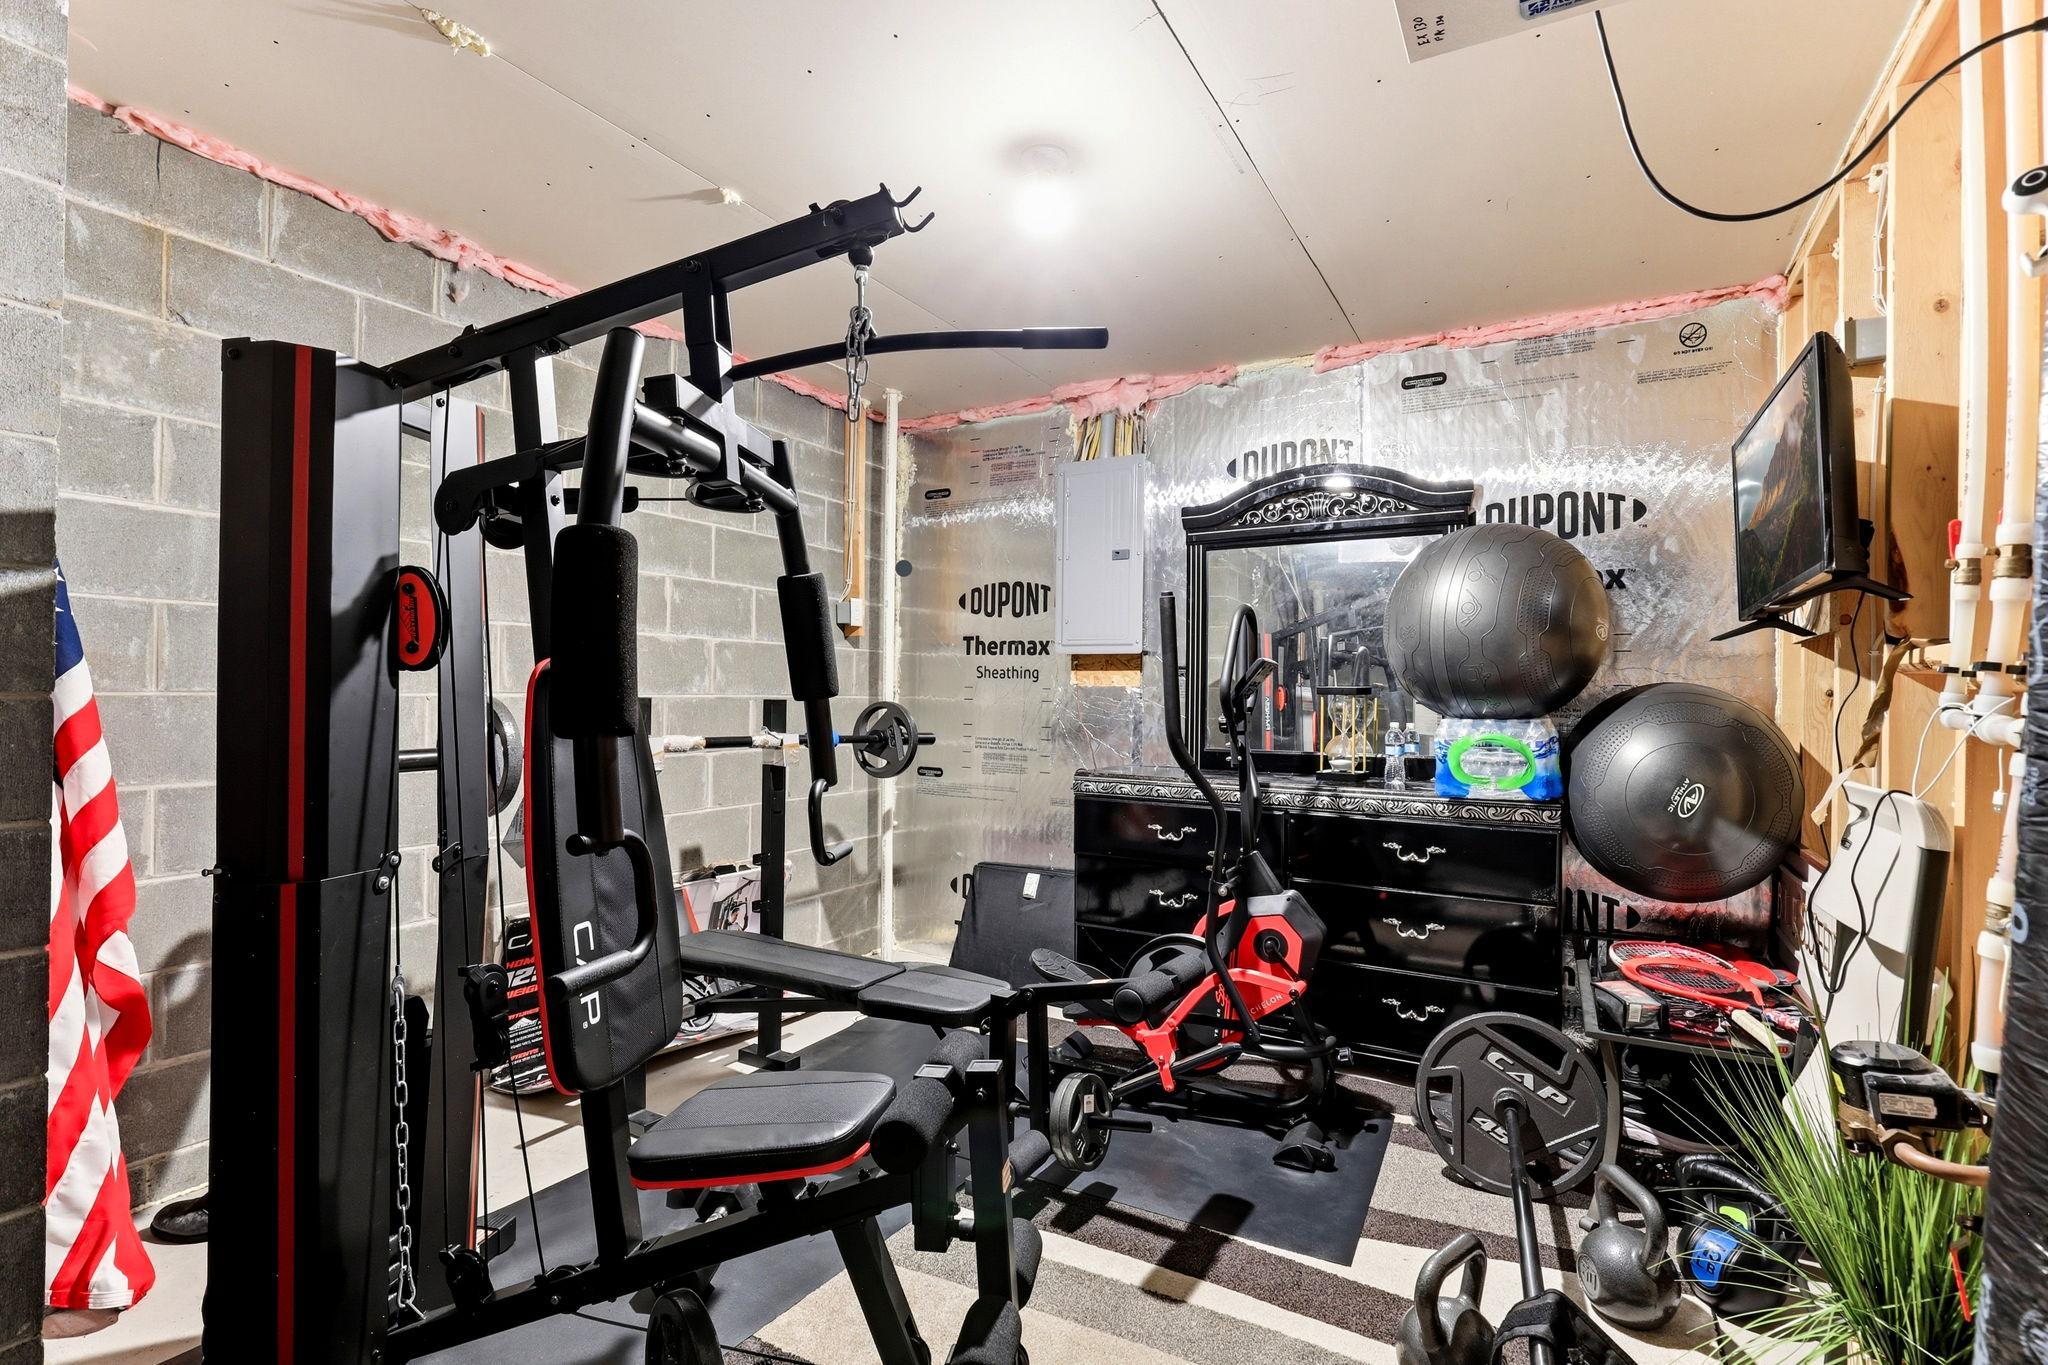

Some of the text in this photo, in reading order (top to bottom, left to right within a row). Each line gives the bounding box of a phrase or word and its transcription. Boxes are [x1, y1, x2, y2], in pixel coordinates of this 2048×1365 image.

[1413, 16, 1428, 32] 130
[970, 581, 1051, 618] DUPONT
[962, 635, 1051, 656] Thermax
[976, 665, 1039, 682] Sheathing
[573, 920, 601, 1025] CP
[1250, 993, 1283, 1015] CHELON
[1486, 1051, 1568, 1104] CAP
[1472, 1116, 1509, 1144] 45
